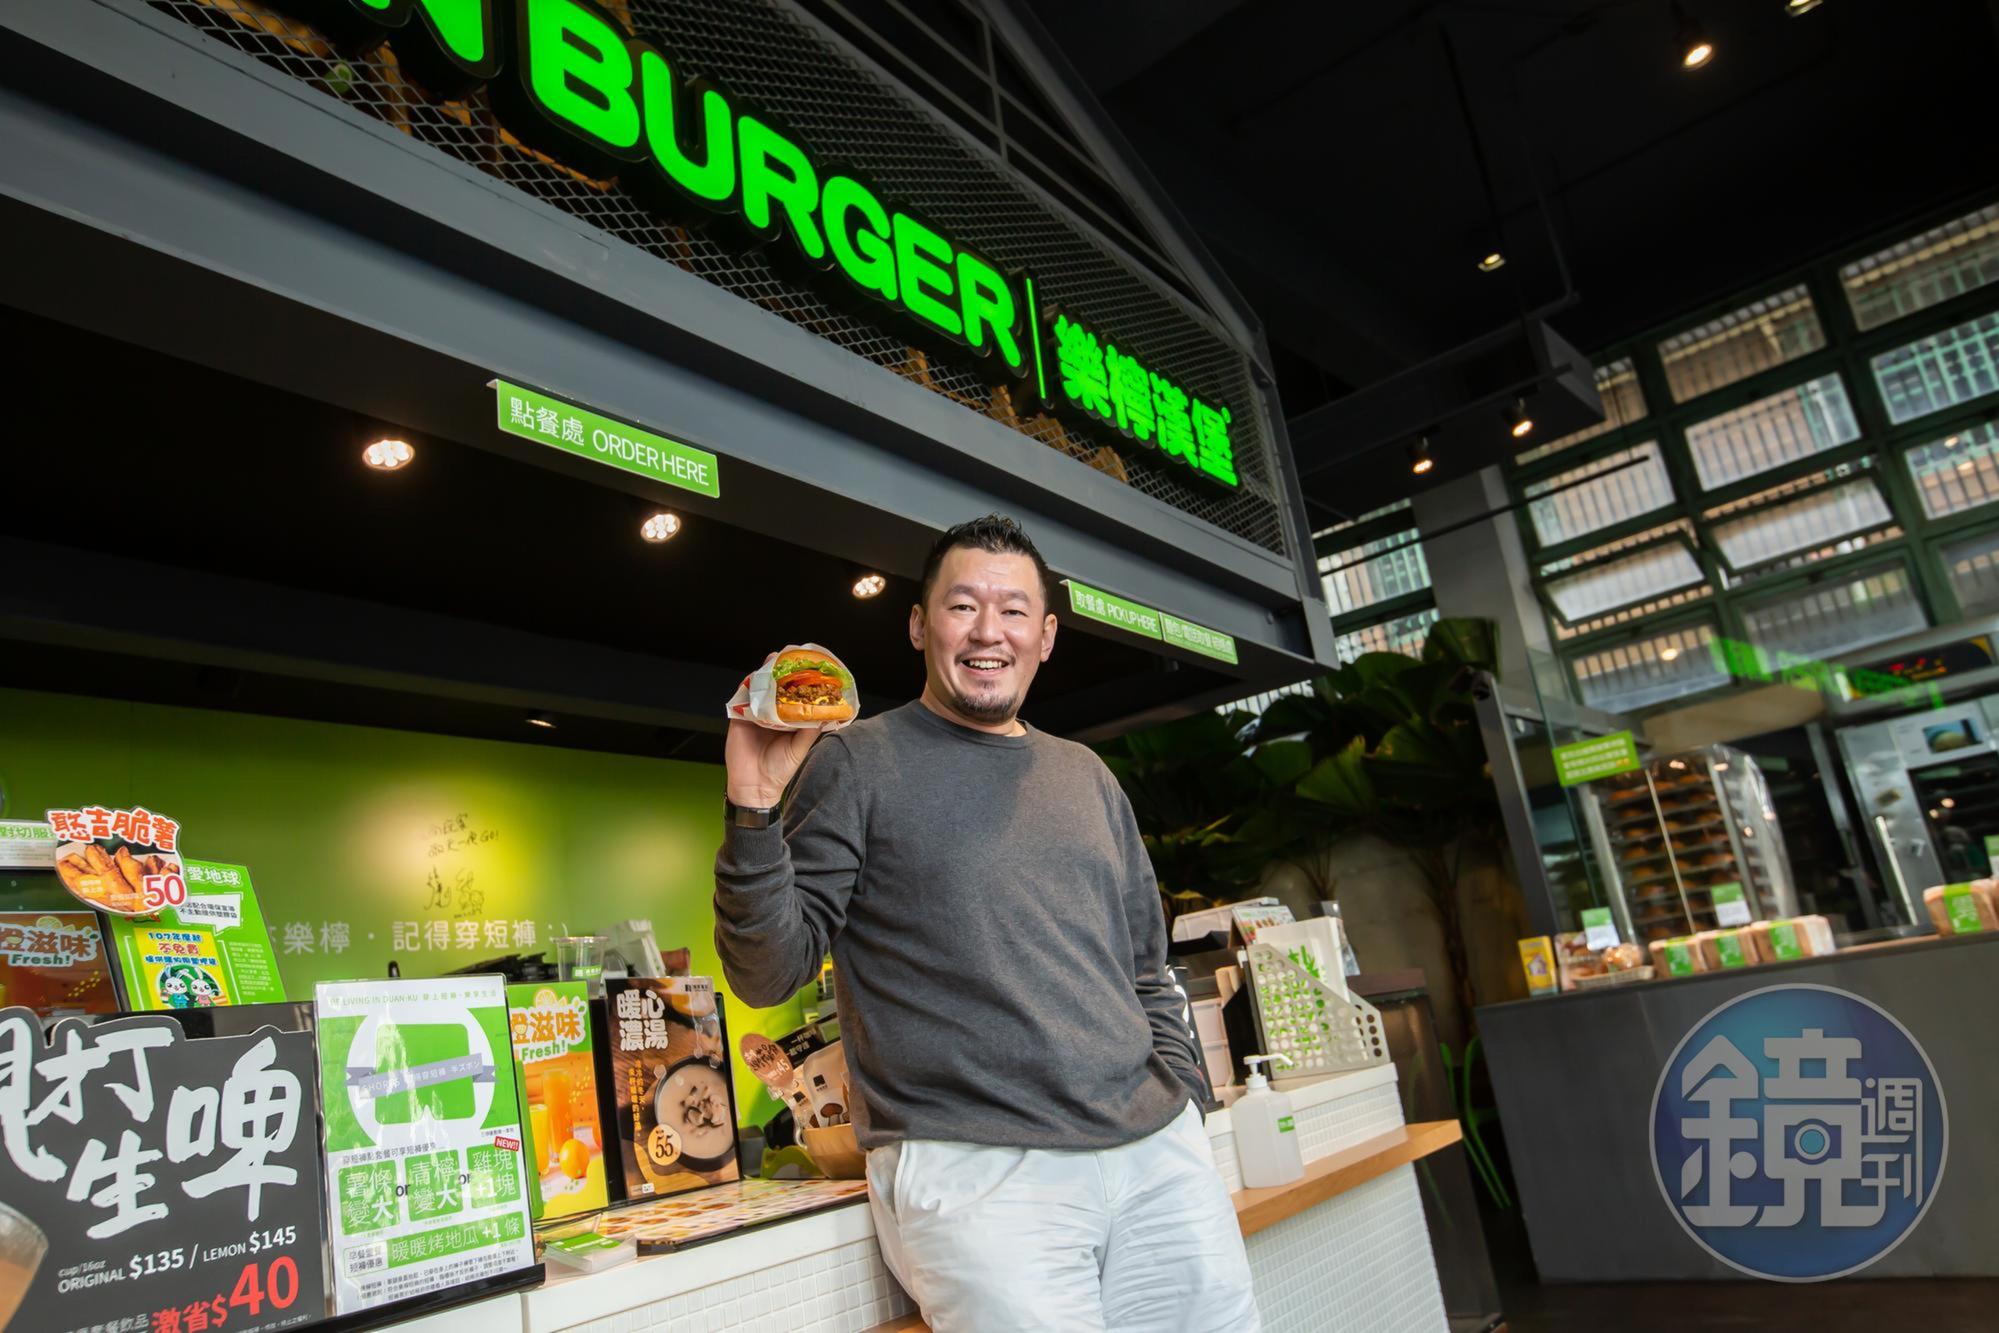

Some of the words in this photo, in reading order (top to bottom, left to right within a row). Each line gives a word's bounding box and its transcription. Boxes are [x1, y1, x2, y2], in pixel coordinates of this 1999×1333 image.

[528, 0, 1021, 367] BURGER
[1054, 314, 1238, 487] 樂檸漢堡
[510, 397, 585, 446] 點餐處
[592, 429, 660, 470] ORDER
[662, 451, 710, 486] HERE
[51, 809, 177, 850] 憨吉脆薯
[145, 875, 185, 907] 50
[12, 954, 71, 965] Fresh!
[616, 989, 666, 1019] 暖心
[521, 1039, 566, 1061] Fresh!
[655, 1133, 674, 1158] 55
[395, 1183, 411, 1197] or
[458, 1173, 471, 1185] or
[57, 1268, 126, 1294] ORIGINAL
[129, 1247, 185, 1280] $135
[203, 1242, 247, 1263] LEMON
[249, 1226, 297, 1255] $145
